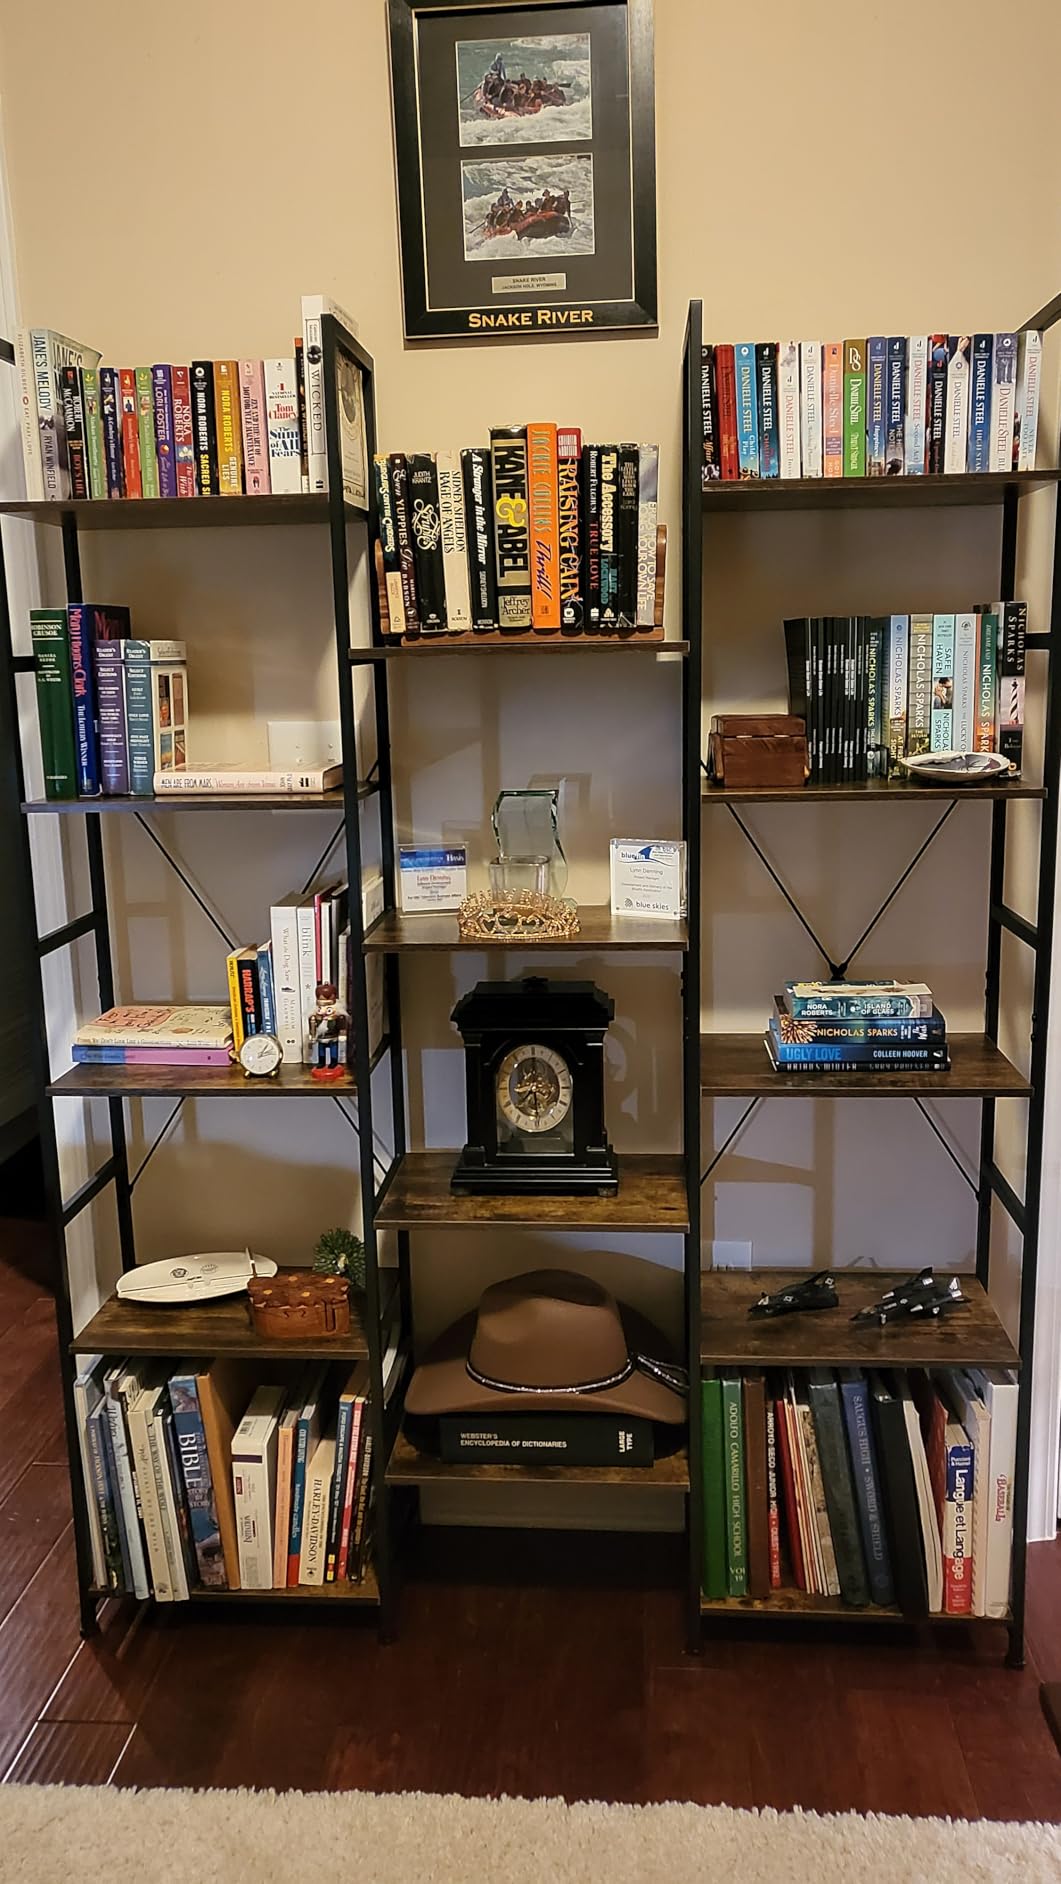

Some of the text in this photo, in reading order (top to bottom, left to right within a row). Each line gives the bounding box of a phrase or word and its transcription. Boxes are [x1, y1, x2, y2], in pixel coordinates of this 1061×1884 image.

[468, 310, 593, 327] SNAKE RIVER
[701, 366, 712, 412] DANIELLE
[850, 378, 862, 406] DANIELLE
[873, 364, 882, 400] DANIELLE
[892, 362, 901, 424] DANIELLE STEEL
[1026, 356, 1038, 418] DANIELLE STEEL
[33, 336, 56, 489] JANE'S MELODY RYAN WINFIELD
[72, 395, 82, 423] ROBERT
[155, 387, 166, 440] LORI FOSTER
[275, 404, 294, 412] Tom
[311, 370, 322, 432] WICKED
[742, 366, 752, 434] DANIELLE STEEL
[828, 364, 840, 434] Danielle Steel
[850, 404, 862, 425] STEEL
[873, 400, 882, 422] STEEL
[933, 380, 944, 440] DANIELLE STEEL
[953, 382, 963, 438] DANIELLE STEEL
[174, 398, 184, 442] ROBERTS
[182, 405, 192, 435] NORA
[220, 390, 234, 452] NORA ROBERTS
[268, 410, 298, 422] Clancy
[702, 414, 713, 436] STEEL
[785, 395, 794, 455] DANIELLE STEEL
[270, 429, 300, 439] Sum
[271, 438, 300, 449] of All
[271, 448, 302, 458] Fears
[472, 453, 483, 462] A
[222, 464, 230, 480] LIES
[228, 456, 238, 488] GENUINE
[471, 464, 484, 504] Stranger
[439, 472, 455, 554] RAGE OF ANGELS
[452, 470, 466, 552] SIDNEY SHELDON
[494, 446, 529, 578] KANE & ABEL
[558, 464, 579, 547] RAISING
[602, 452, 618, 552] The Accessory
[395, 499, 408, 546] YUPPIES
[475, 516, 486, 531] the
[589, 450, 600, 590] ROBERT FULGHUM TRUE LOVE
[476, 532, 488, 565] Mirror
[401, 574, 410, 608] BABSON
[560, 552, 580, 600] CAIN
[638, 563, 648, 590] OWN
[637, 592, 646, 610] LIFE
[69, 608, 82, 635] Mary
[1006, 616, 1017, 663] SPARKS
[1016, 607, 1026, 671] NICHOLAS
[936, 644, 944, 674] HAVEN
[944, 648, 952, 670] SAFE
[73, 669, 88, 698] Clark
[894, 636, 903, 716] NICHOLAS SPARKS
[915, 634, 926, 728] NICHOLAS SPARKS
[934, 720, 942, 749] SPARKS
[301, 928, 312, 956] blink
[282, 954, 292, 968] Dog
[242, 969, 255, 1013] HARRAP'S
[864, 1002, 892, 1010] ISLAND
[817, 1028, 898, 1037] NICHOLAS SPARKS
[786, 1047, 841, 1060] UGLY LOVE
[873, 1050, 928, 1058] COLLEEN HOOVER
[852, 1396, 867, 1437] SAUGUS
[460, 1432, 498, 1440] WEBSTER'S
[522, 1440, 568, 1448] DICTIONARIES
[626, 1433, 634, 1450] TYPE
[858, 1438, 871, 1464] HIGH
[154, 1465, 162, 1476] OF
[178, 1433, 201, 1489] BIBLE
[155, 1476, 164, 1490] THE
[729, 1402, 742, 1557] ADOLFO CAMARILLO HIGH SCHOOL
[864, 1476, 877, 1512] SWORD
[952, 1469, 968, 1513] Langue
[158, 1491, 166, 1511] WOLF
[995, 1477, 1008, 1522] BASEBALL
[308, 1479, 322, 1562] HARLEY-DAVIDSON
[955, 1515, 966, 1528] et
[870, 1524, 884, 1561] SHIELD
[952, 1530, 966, 1580] Langage
